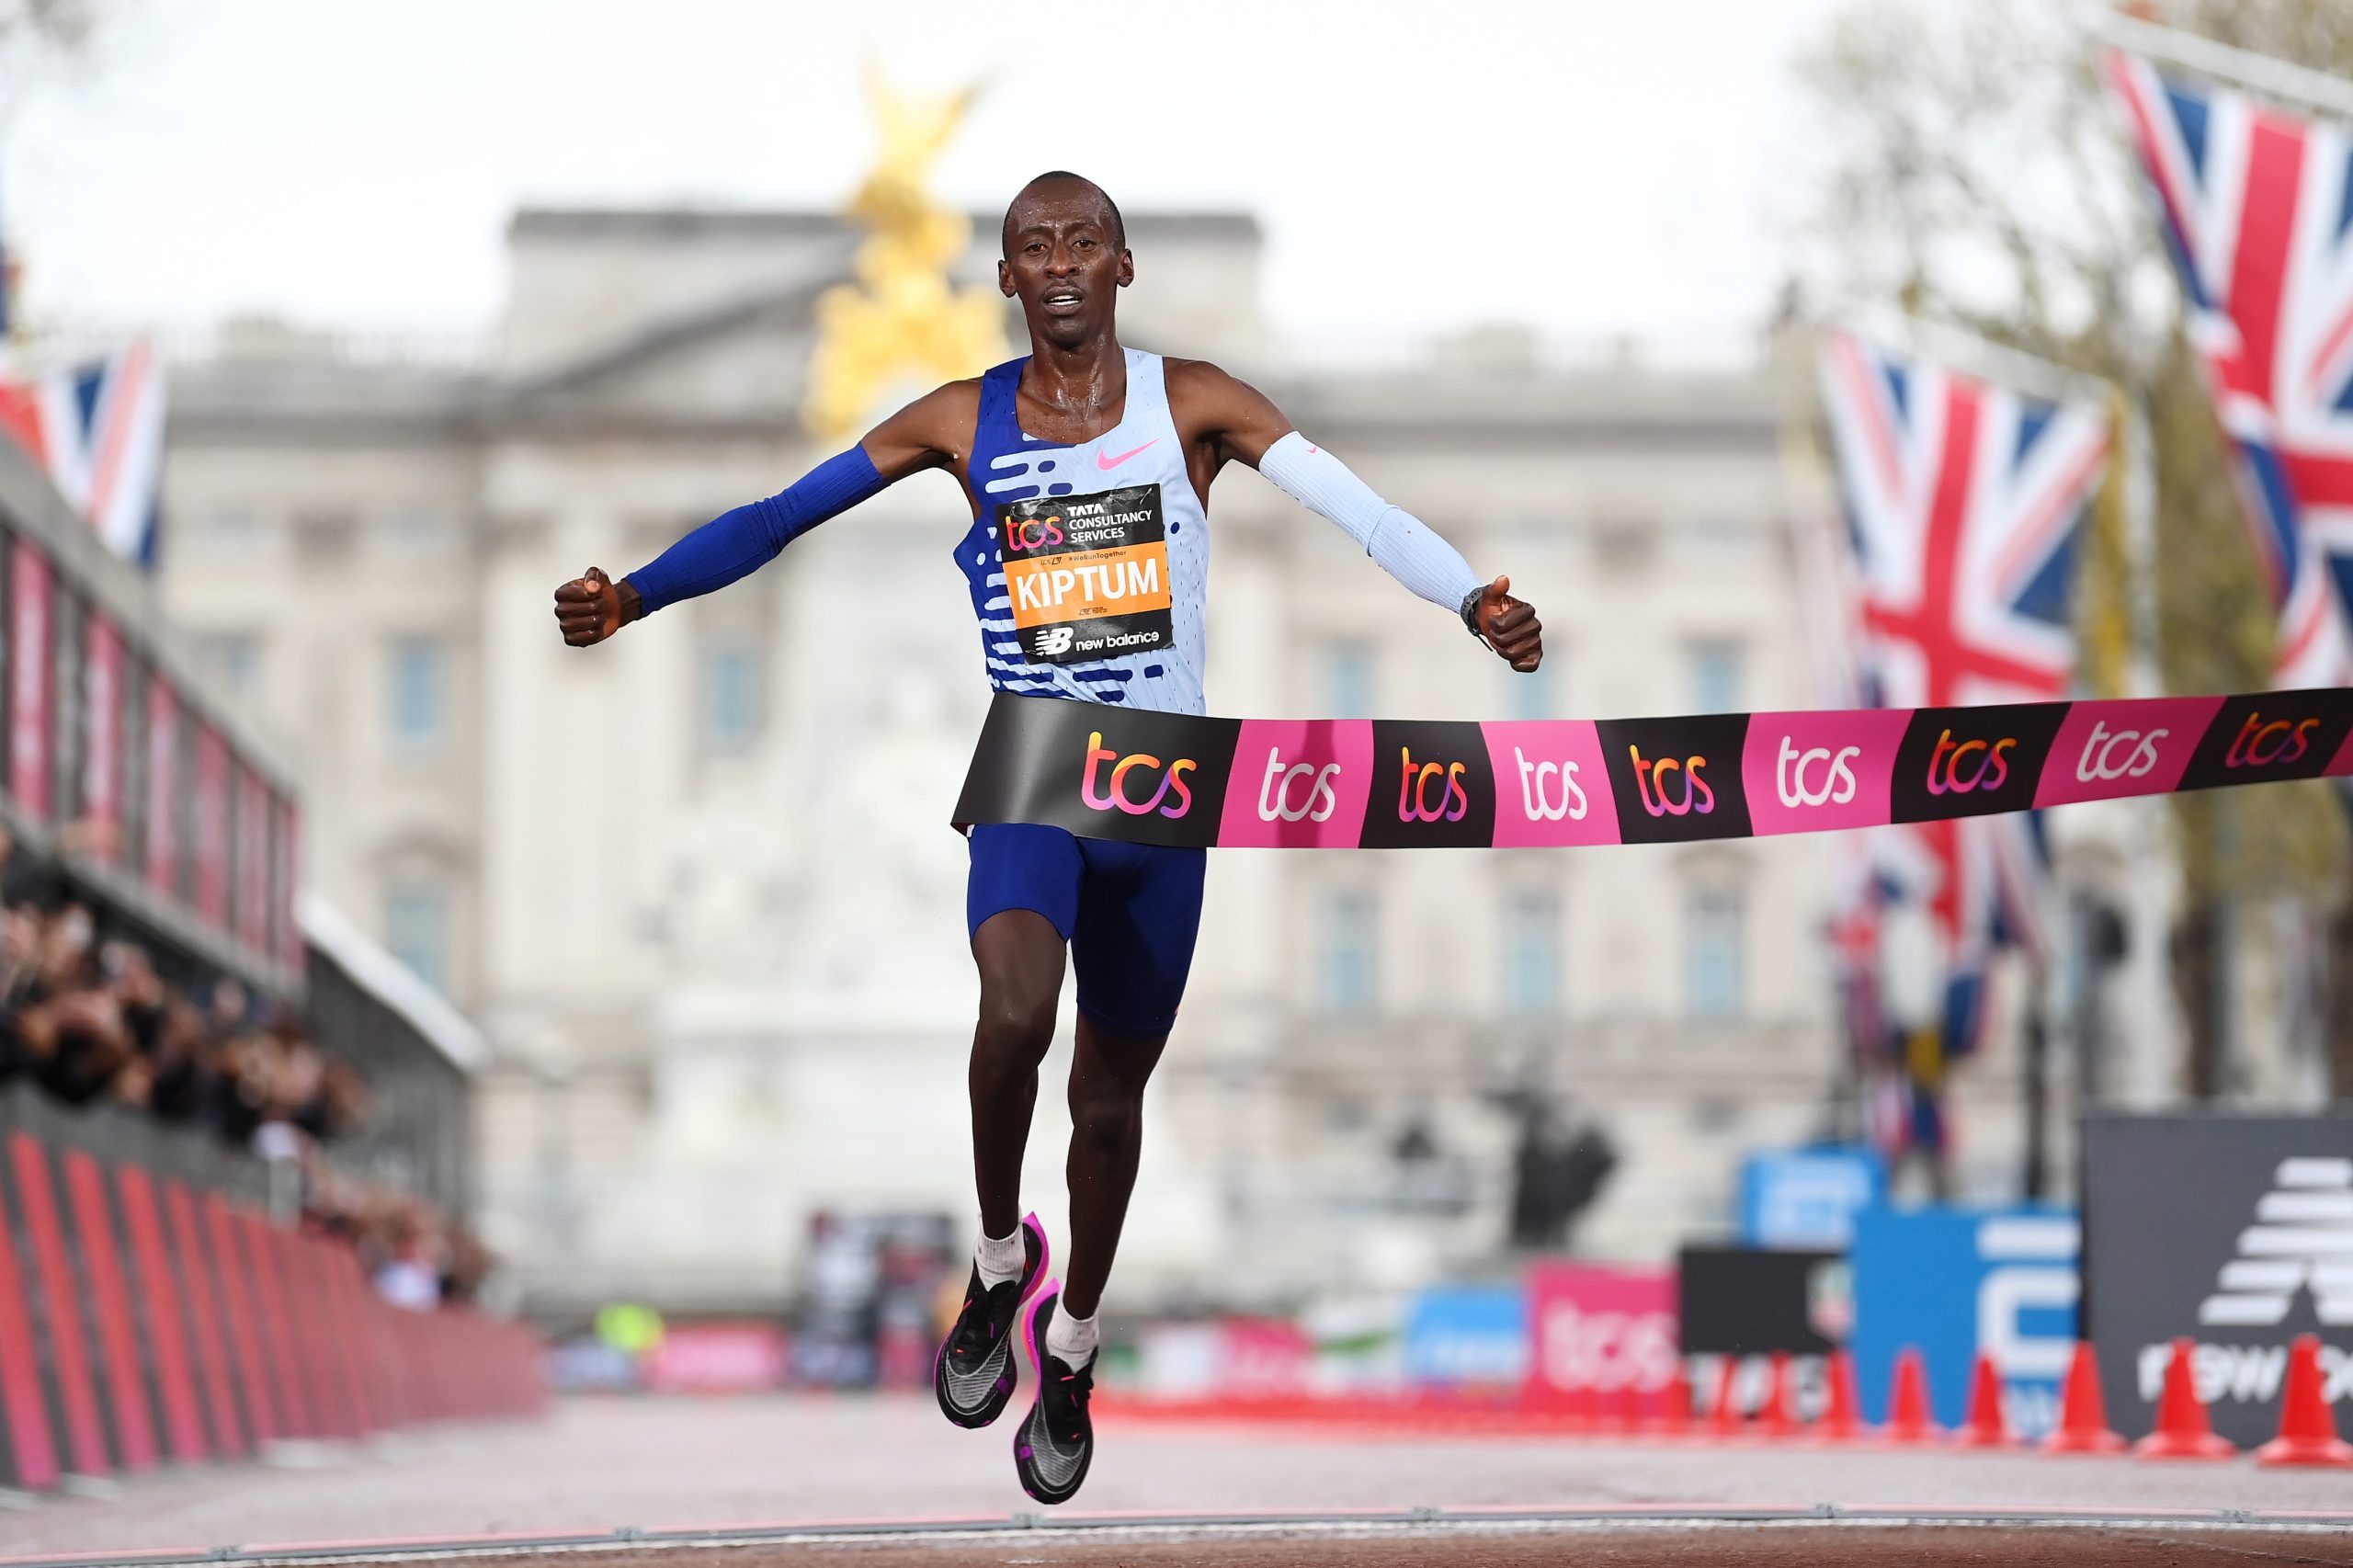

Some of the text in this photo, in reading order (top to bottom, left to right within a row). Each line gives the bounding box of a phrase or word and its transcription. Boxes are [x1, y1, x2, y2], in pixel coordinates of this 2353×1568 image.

[1067, 503, 1105, 517] TATA
[1069, 510, 1153, 530] CONSULTANCY
[1005, 516, 1063, 551] tcs
[1070, 527, 1125, 543] SERVICES
[1068, 551, 1127, 562] #WeRunTogether
[1015, 558, 1159, 610] KIPTUM
[1075, 631, 1160, 652] new balance
[1082, 712, 2319, 822] tcs tcs tcs tcs tcs tcs tcs tcs tcs
